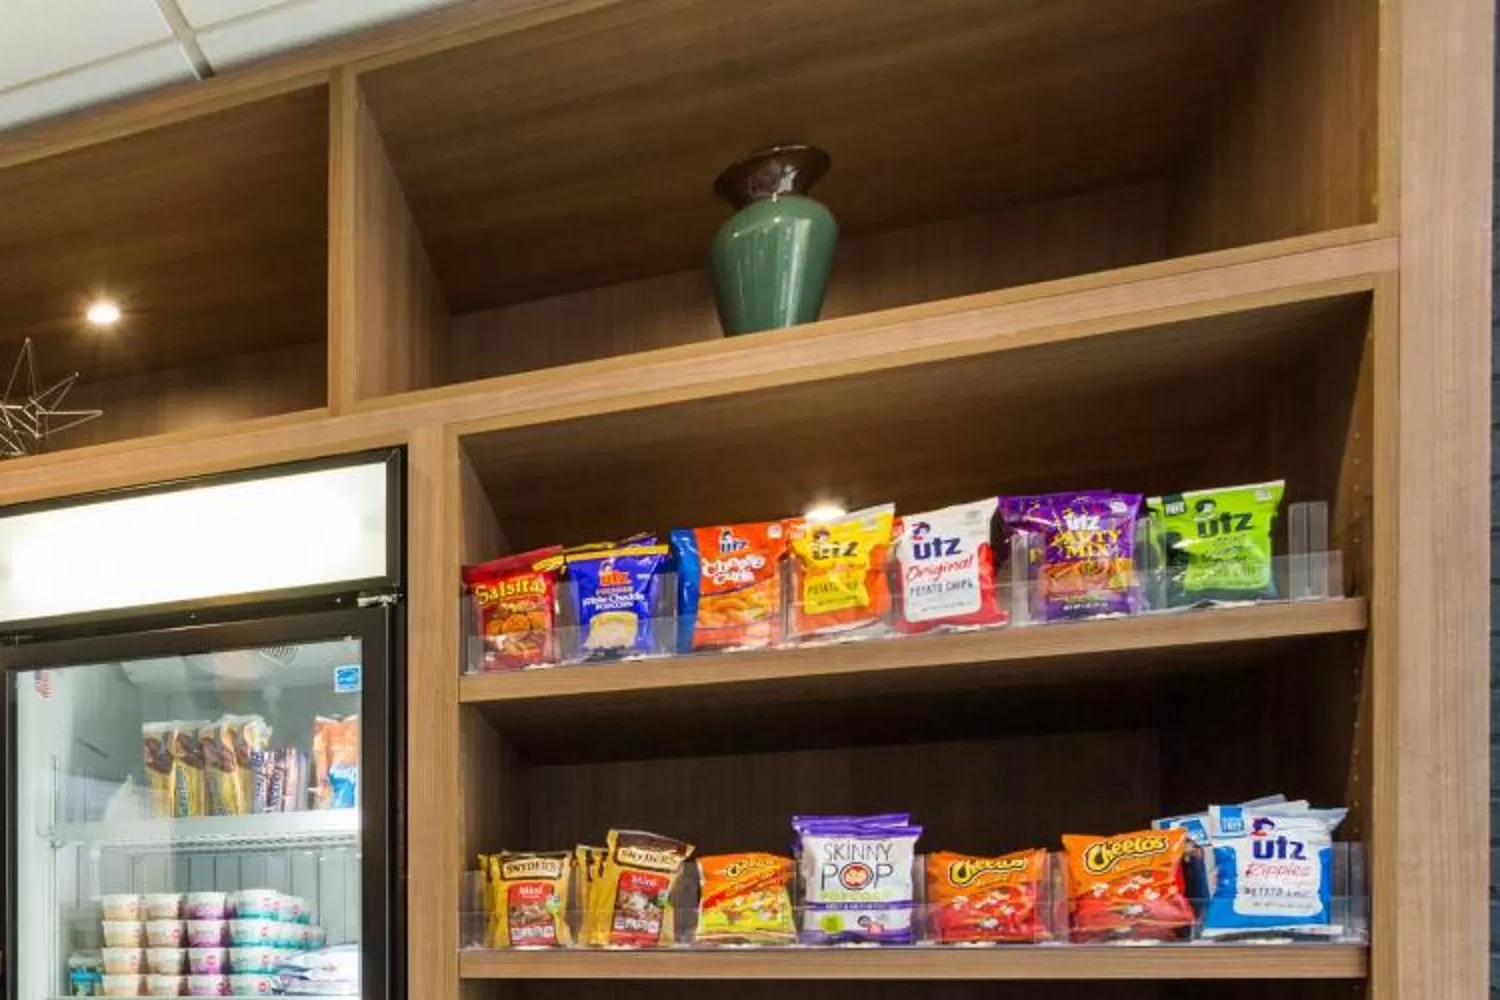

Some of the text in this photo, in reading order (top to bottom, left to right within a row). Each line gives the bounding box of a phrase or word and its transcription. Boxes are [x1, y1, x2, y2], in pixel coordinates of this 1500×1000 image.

[1197, 512, 1254, 538] utz
[913, 537, 963, 560] utz
[906, 553, 974, 582] Original
[822, 842, 894, 862] SKINNY
[1084, 835, 1166, 874] Cheetos
[1253, 835, 1307, 861] utz
[821, 862, 894, 890] POP
[950, 858, 1028, 886] Cheetos
